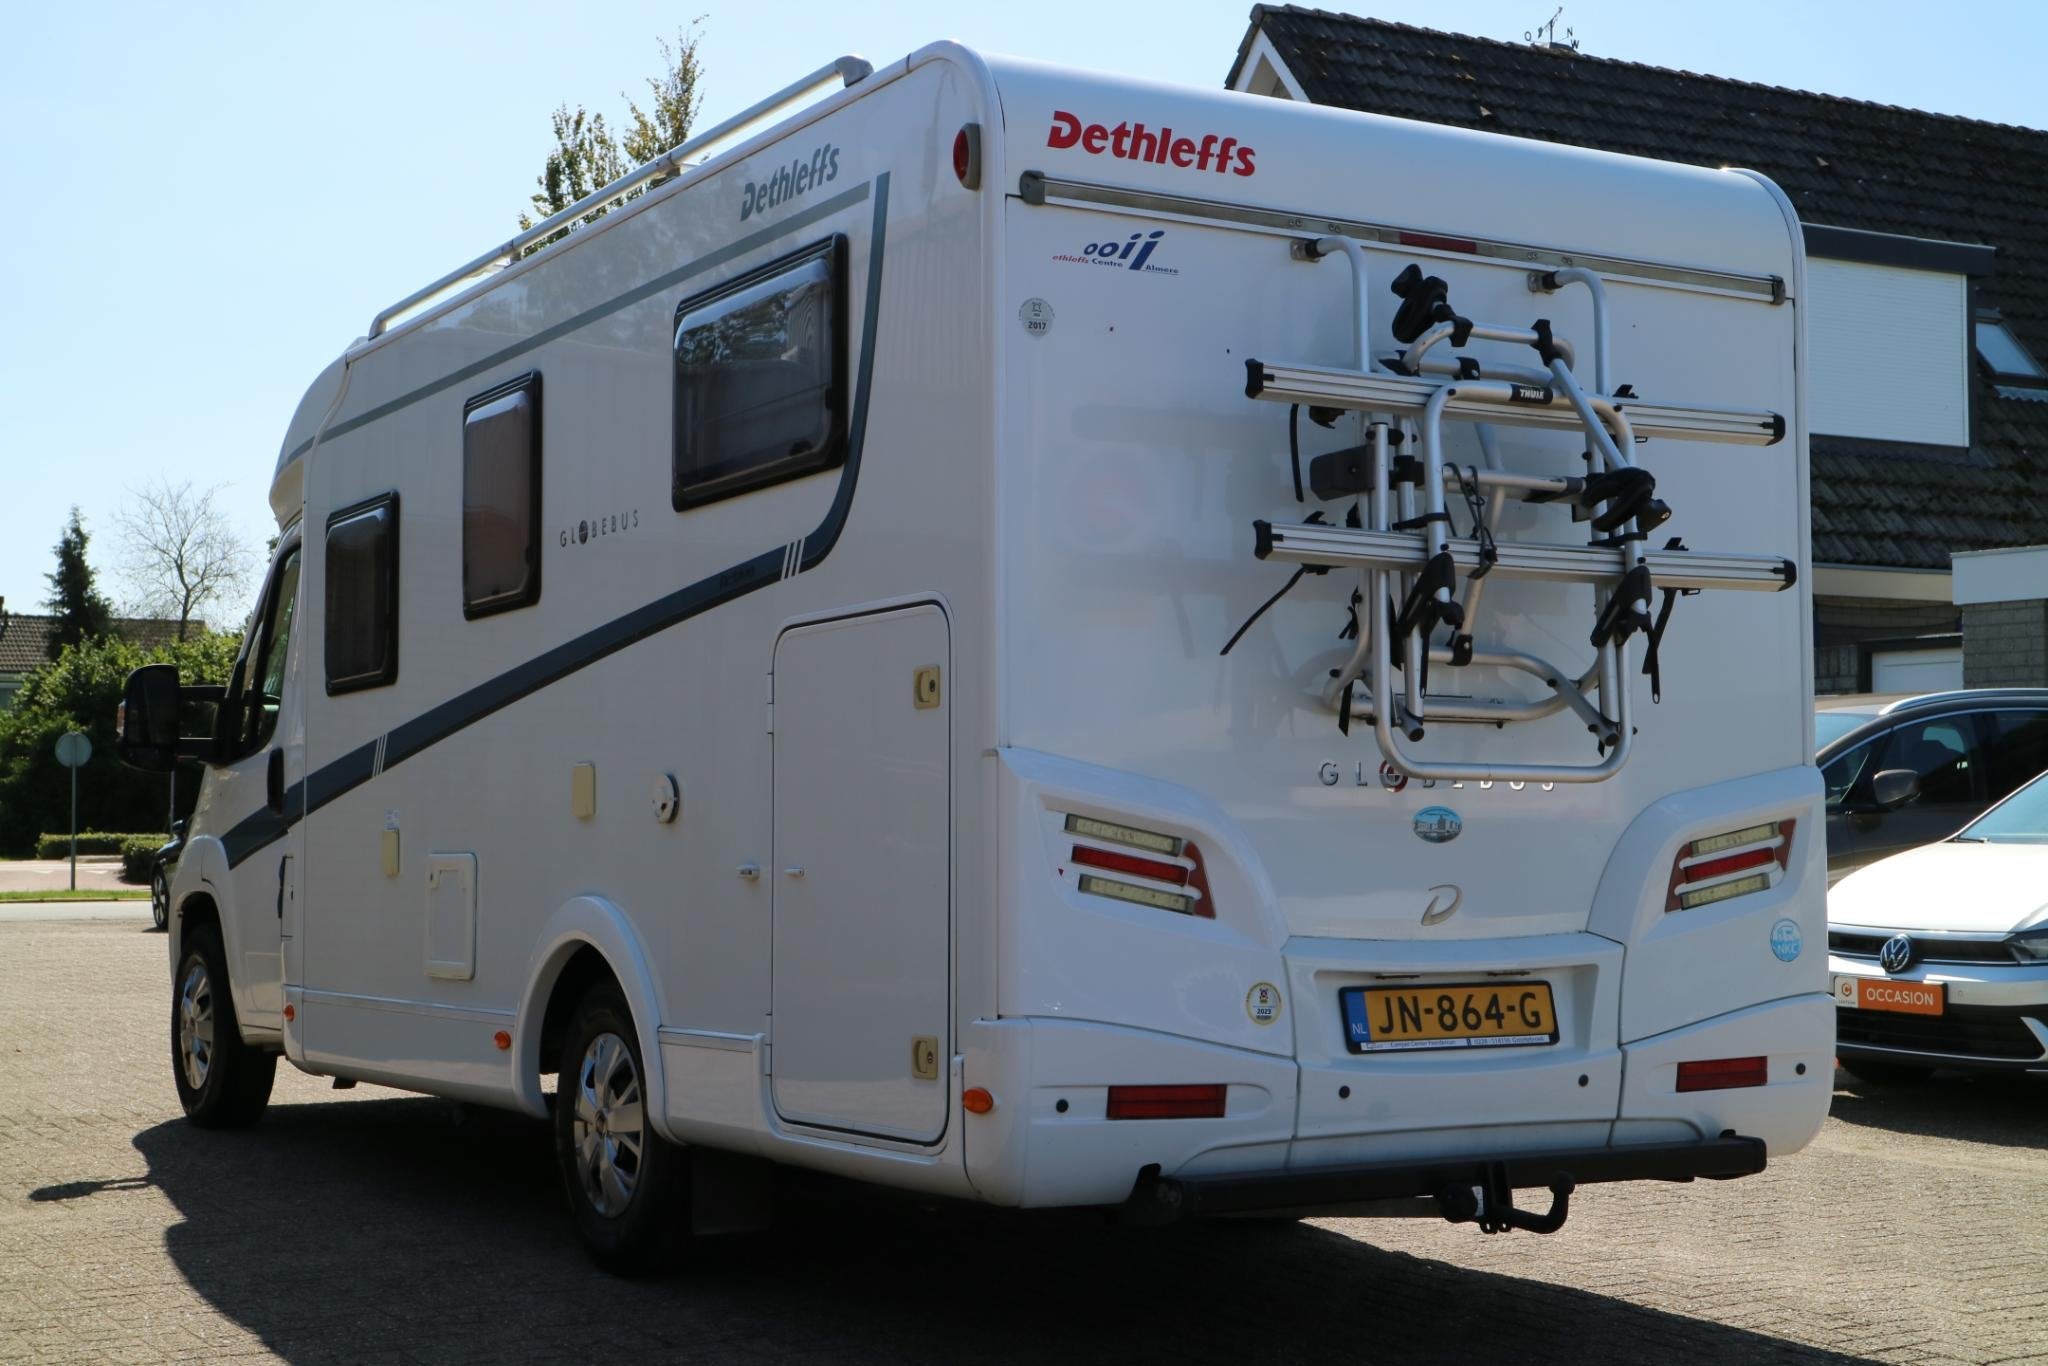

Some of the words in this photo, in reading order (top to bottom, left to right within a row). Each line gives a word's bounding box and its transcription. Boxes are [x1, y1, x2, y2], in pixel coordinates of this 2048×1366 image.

[1047, 110, 1256, 177] Dethleffs
[740, 143, 840, 222] Dethleffs
[1092, 257, 1124, 268] Centre
[1145, 264, 1179, 274] Almere
[1028, 320, 1047, 331] 2017
[1520, 389, 1545, 400] THULE
[559, 509, 639, 548] GLOBEBUS
[1866, 987, 1934, 1006] OCCASION
[1352, 1023, 1367, 1035] NL
[1378, 991, 1542, 1035] JN-864-G
